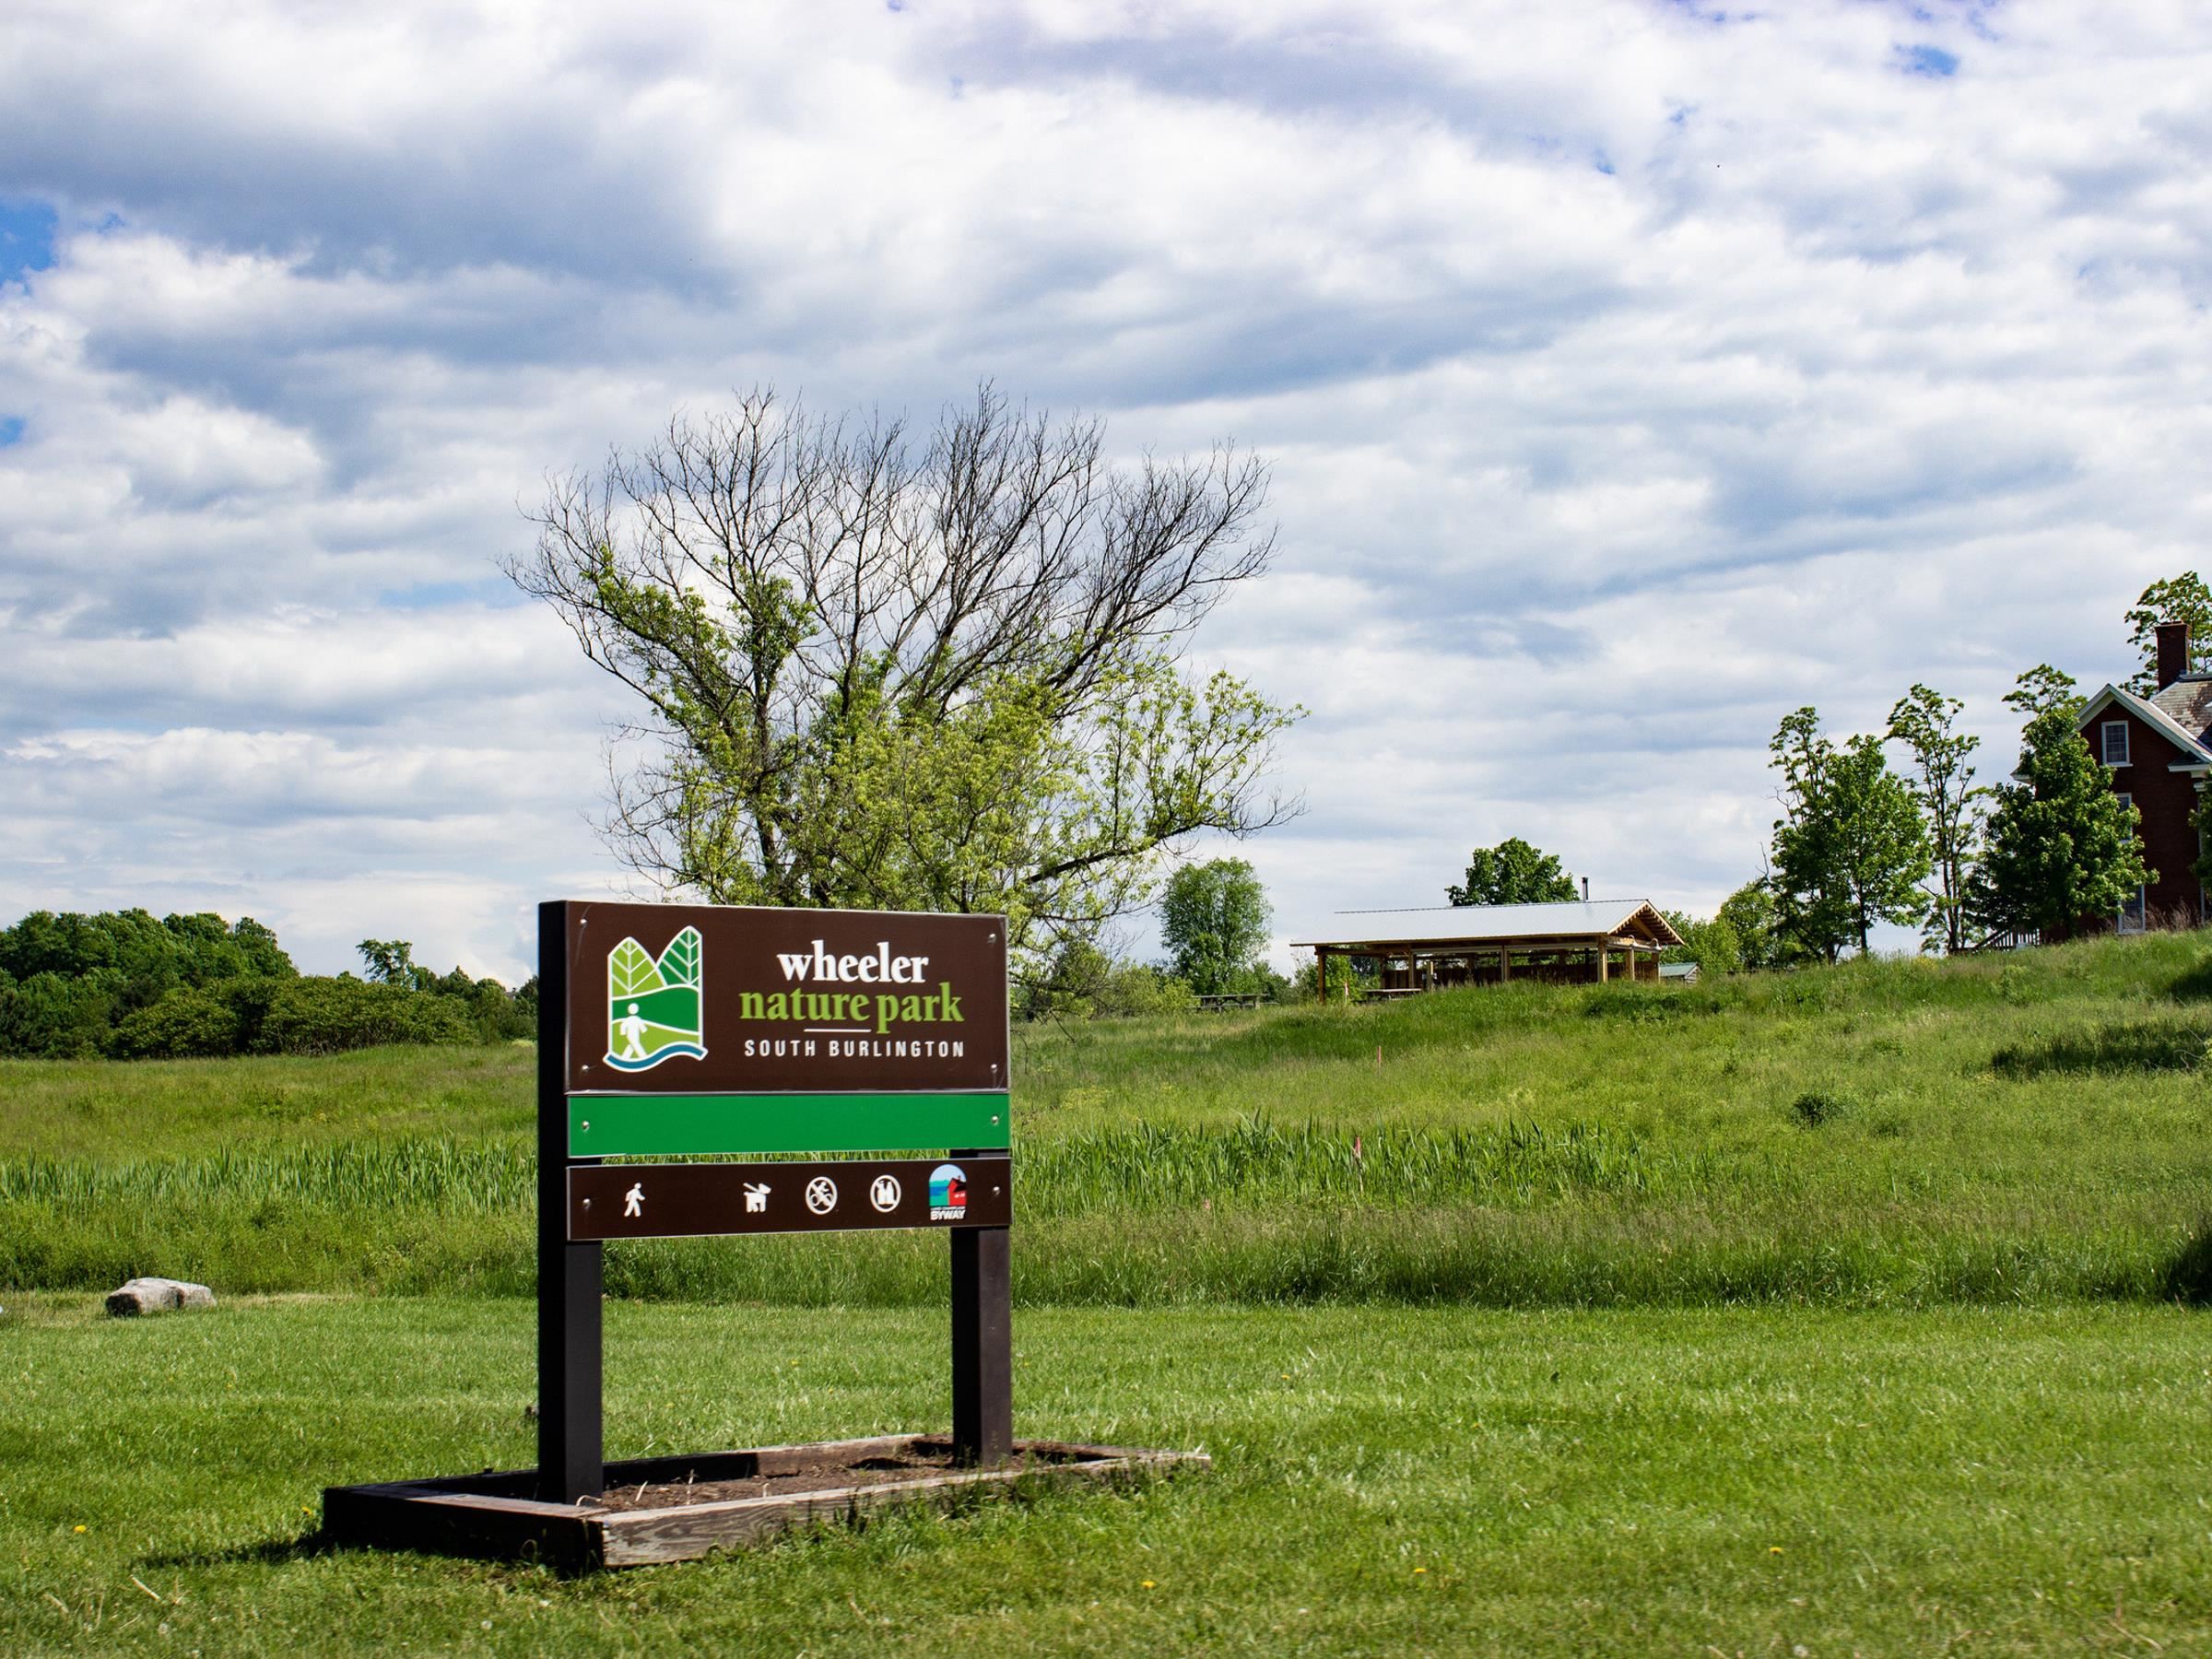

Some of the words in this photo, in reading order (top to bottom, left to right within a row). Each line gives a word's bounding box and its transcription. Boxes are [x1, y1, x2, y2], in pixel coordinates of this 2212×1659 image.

[776, 939, 929, 983] wheeler
[739, 987, 870, 1021] nature
[875, 982, 965, 1034] park
[744, 1040, 816, 1057] SOUTH
[830, 1041, 964, 1058] BURLINGTON
[930, 1209, 966, 1220] BYWAY
